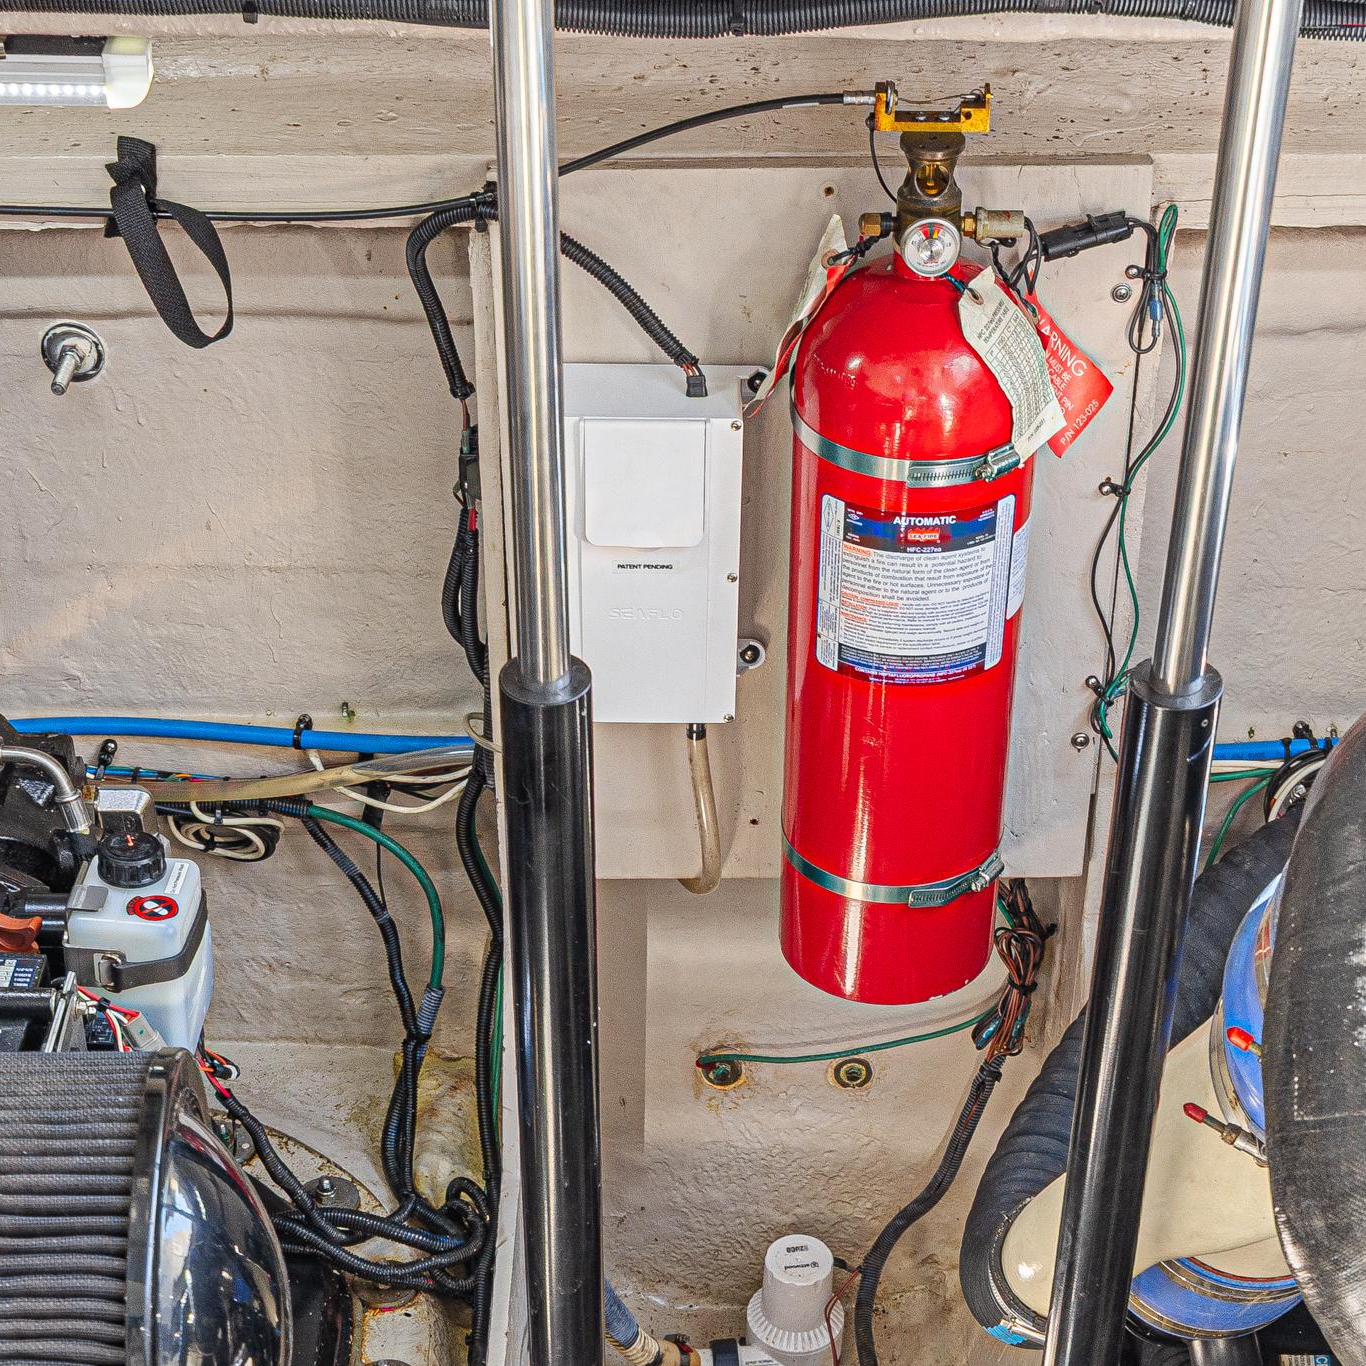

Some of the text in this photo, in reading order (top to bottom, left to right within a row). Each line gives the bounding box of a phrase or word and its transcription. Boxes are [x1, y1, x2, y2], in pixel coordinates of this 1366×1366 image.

[1073, 399, 1099, 430] 123-025
[893, 516, 957, 526] AUTOMATIC
[609, 608, 684, 620] SEAFLO
[785, 1263, 810, 1271] attwood
